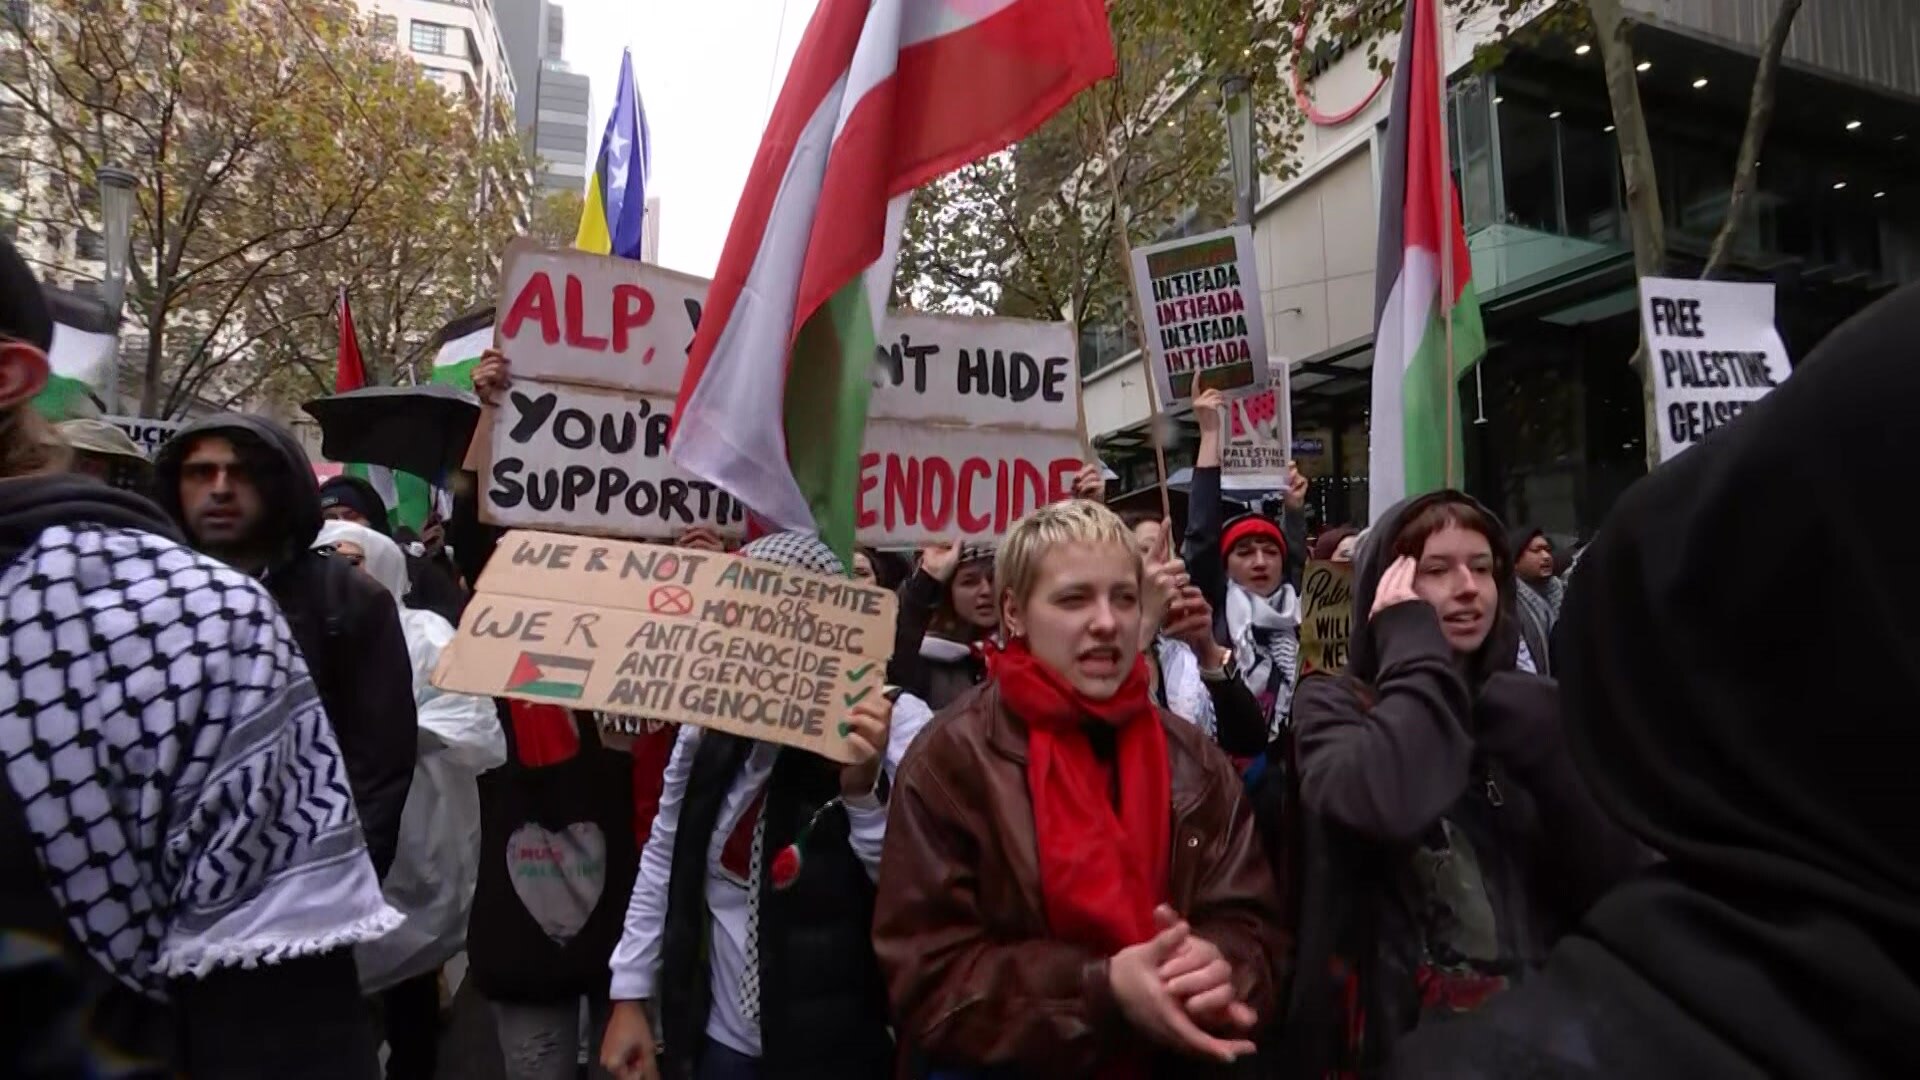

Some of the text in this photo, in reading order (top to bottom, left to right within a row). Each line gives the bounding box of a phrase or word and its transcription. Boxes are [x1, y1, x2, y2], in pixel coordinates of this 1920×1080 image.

[1151, 264, 1241, 303] INTIFADA
[1155, 288, 1245, 327] INTIFADA
[1651, 296, 1705, 338] FREE
[502, 271, 655, 365] ALP,
[957, 347, 1069, 402] HIDE
[1159, 314, 1249, 350] INTIFADA
[1163, 339, 1251, 374] INTIFADA
[1660, 349, 1778, 388] PALESTINE
[1223, 447, 1285, 458] PALESTINE
[1223, 458, 1249, 469] WILL
[1252, 458, 1265, 468] BE
[512, 540, 578, 569] WE
[584, 547, 609, 572] R
[620, 550, 708, 584] NOT
[470, 606, 552, 641] WE
[564, 613, 601, 648] R
